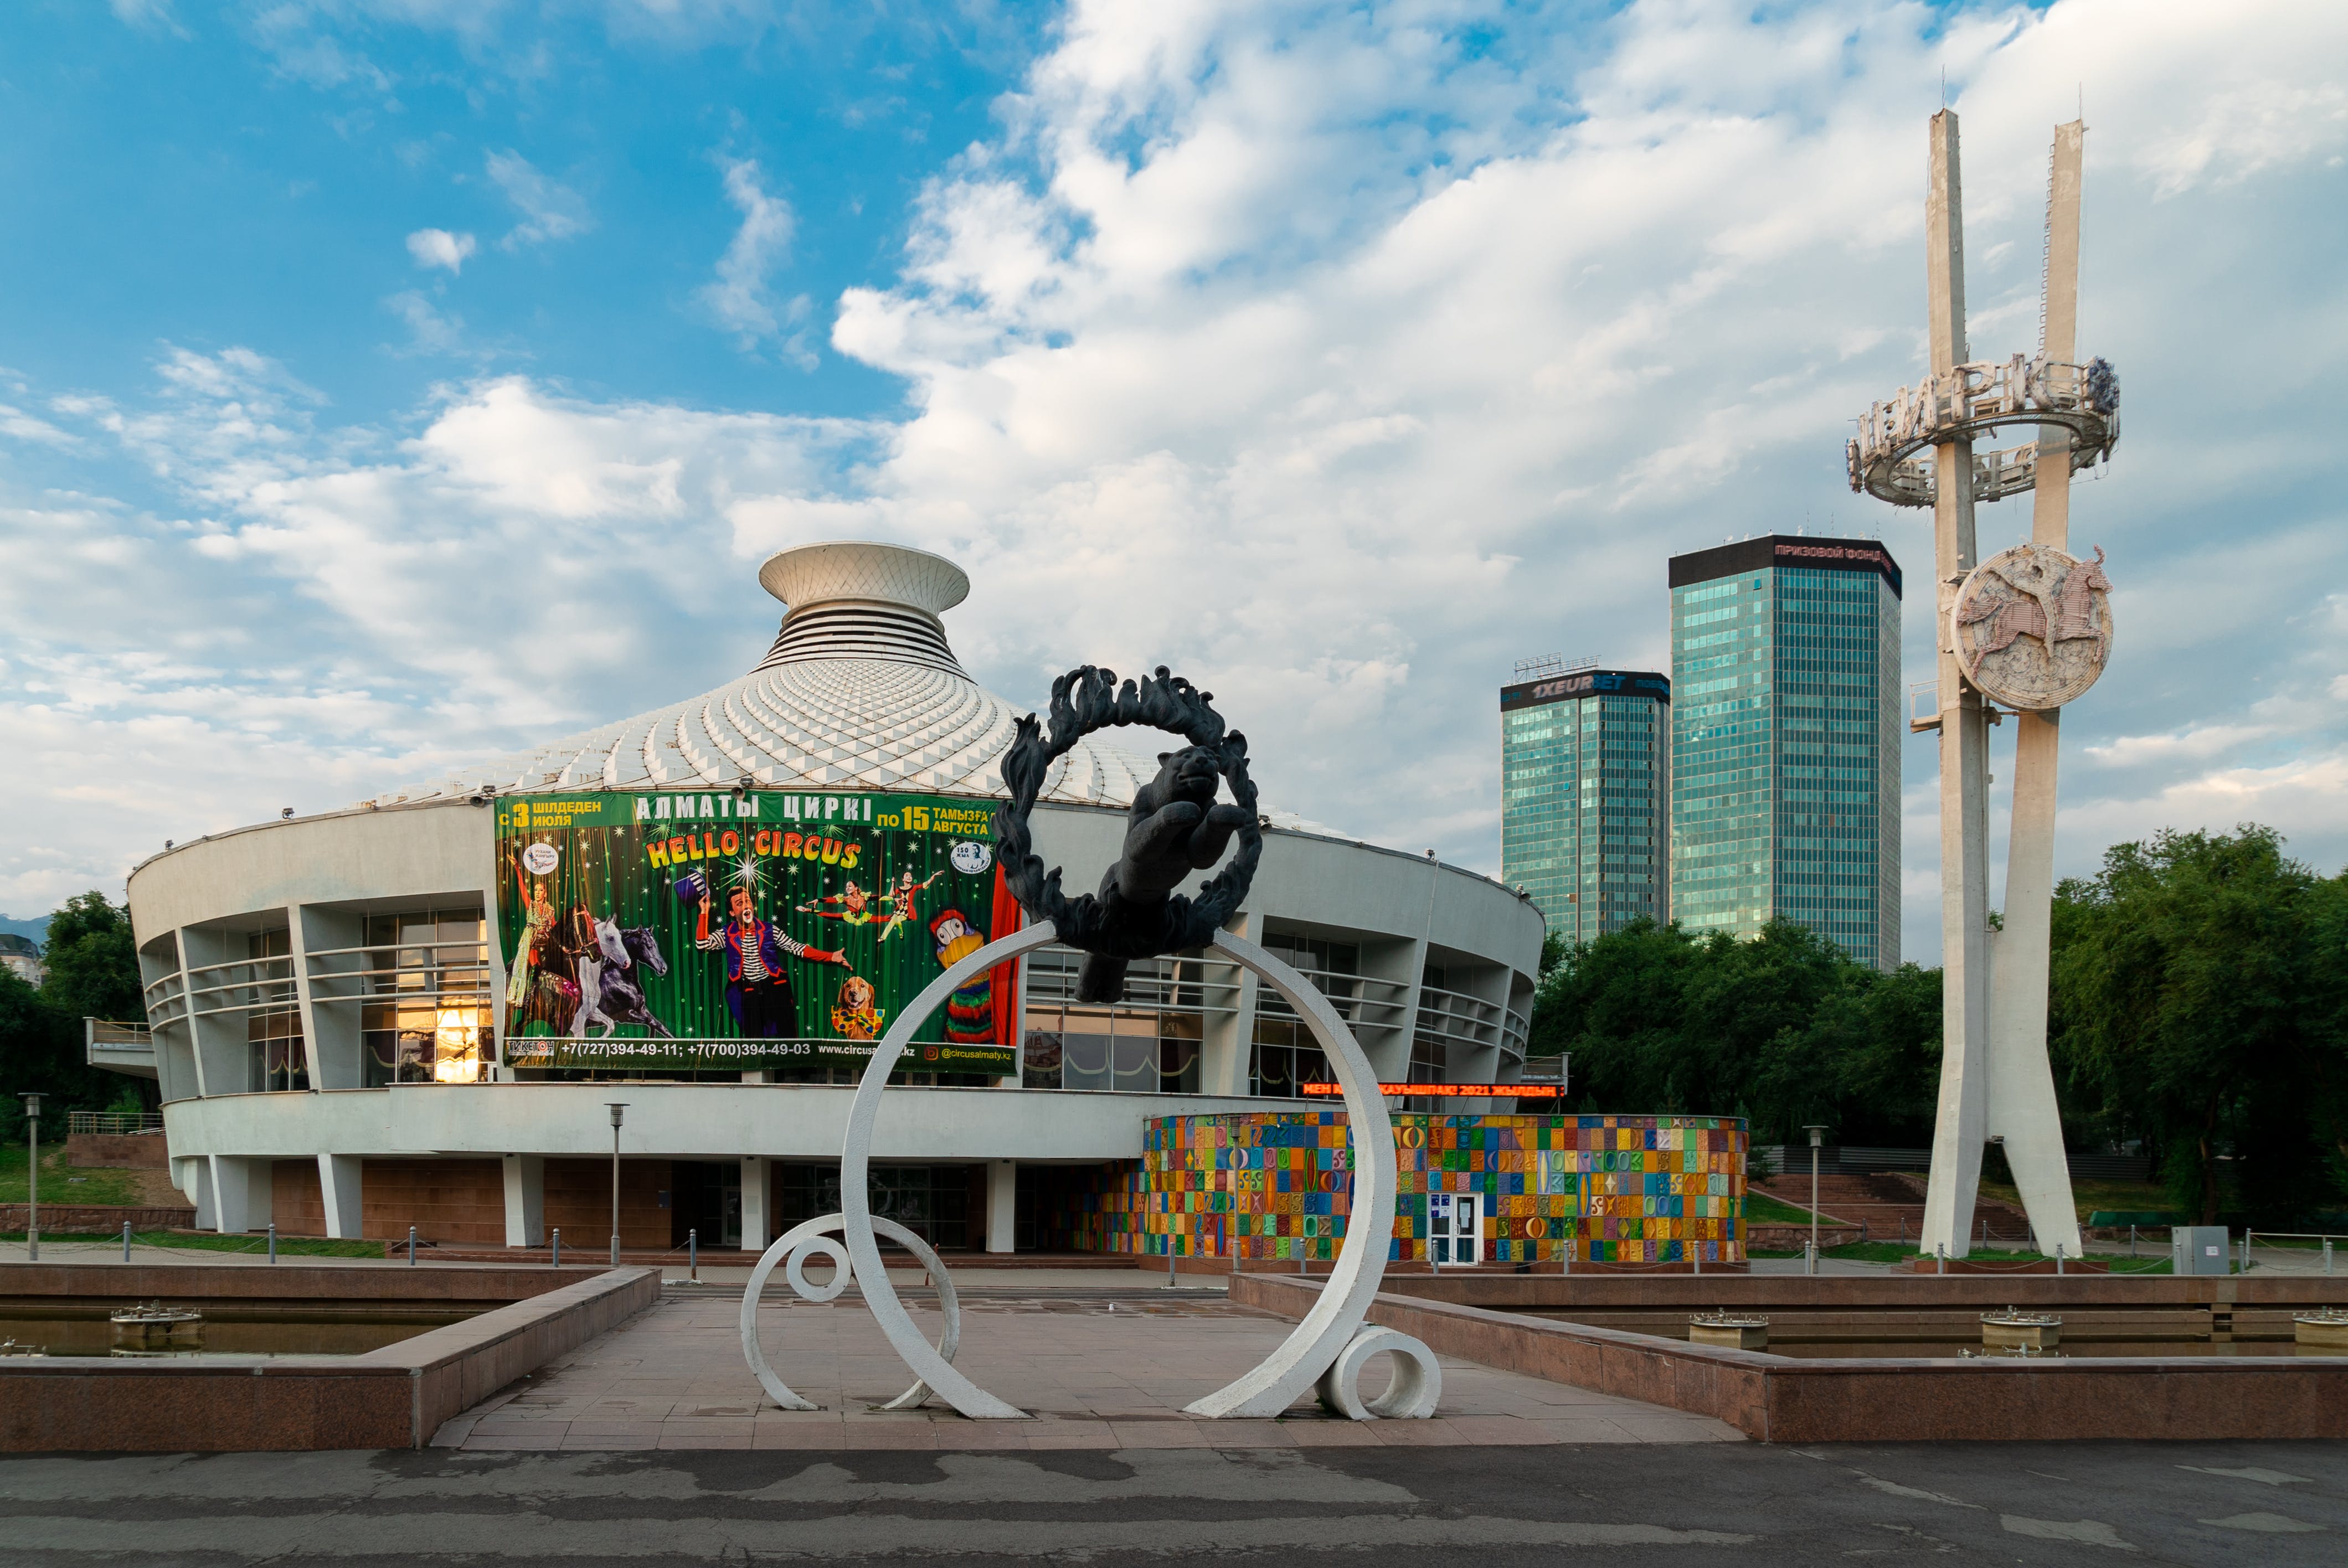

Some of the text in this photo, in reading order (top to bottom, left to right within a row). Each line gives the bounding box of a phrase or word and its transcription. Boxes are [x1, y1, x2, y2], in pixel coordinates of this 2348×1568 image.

[1858, 349, 2052, 458] ЦИРК
[1775, 545, 1881, 563] ПРИЗОВОЙ ФОНД
[513, 803, 529, 827] 3
[533, 801, 602, 814] ШІЛДЕДЕН
[636, 795, 872, 821] АЛМАТЫ ЦИРКІ
[533, 815, 571, 827] ИЮЛЯ
[901, 806, 929, 831] 15
[933, 807, 988, 822] ТАМЫЗҒА
[933, 821, 988, 835] АВГУСТА
[645, 829, 862, 869] HELLO CIRCUS
[508, 1041, 555, 1051] ТИКЕТОН
[687, 1043, 811, 1058] +7(700)394-49-03
[941, 1048, 1012, 1060] @circusalmaty.kz
[1459, 1085, 1491, 1096] 2021
